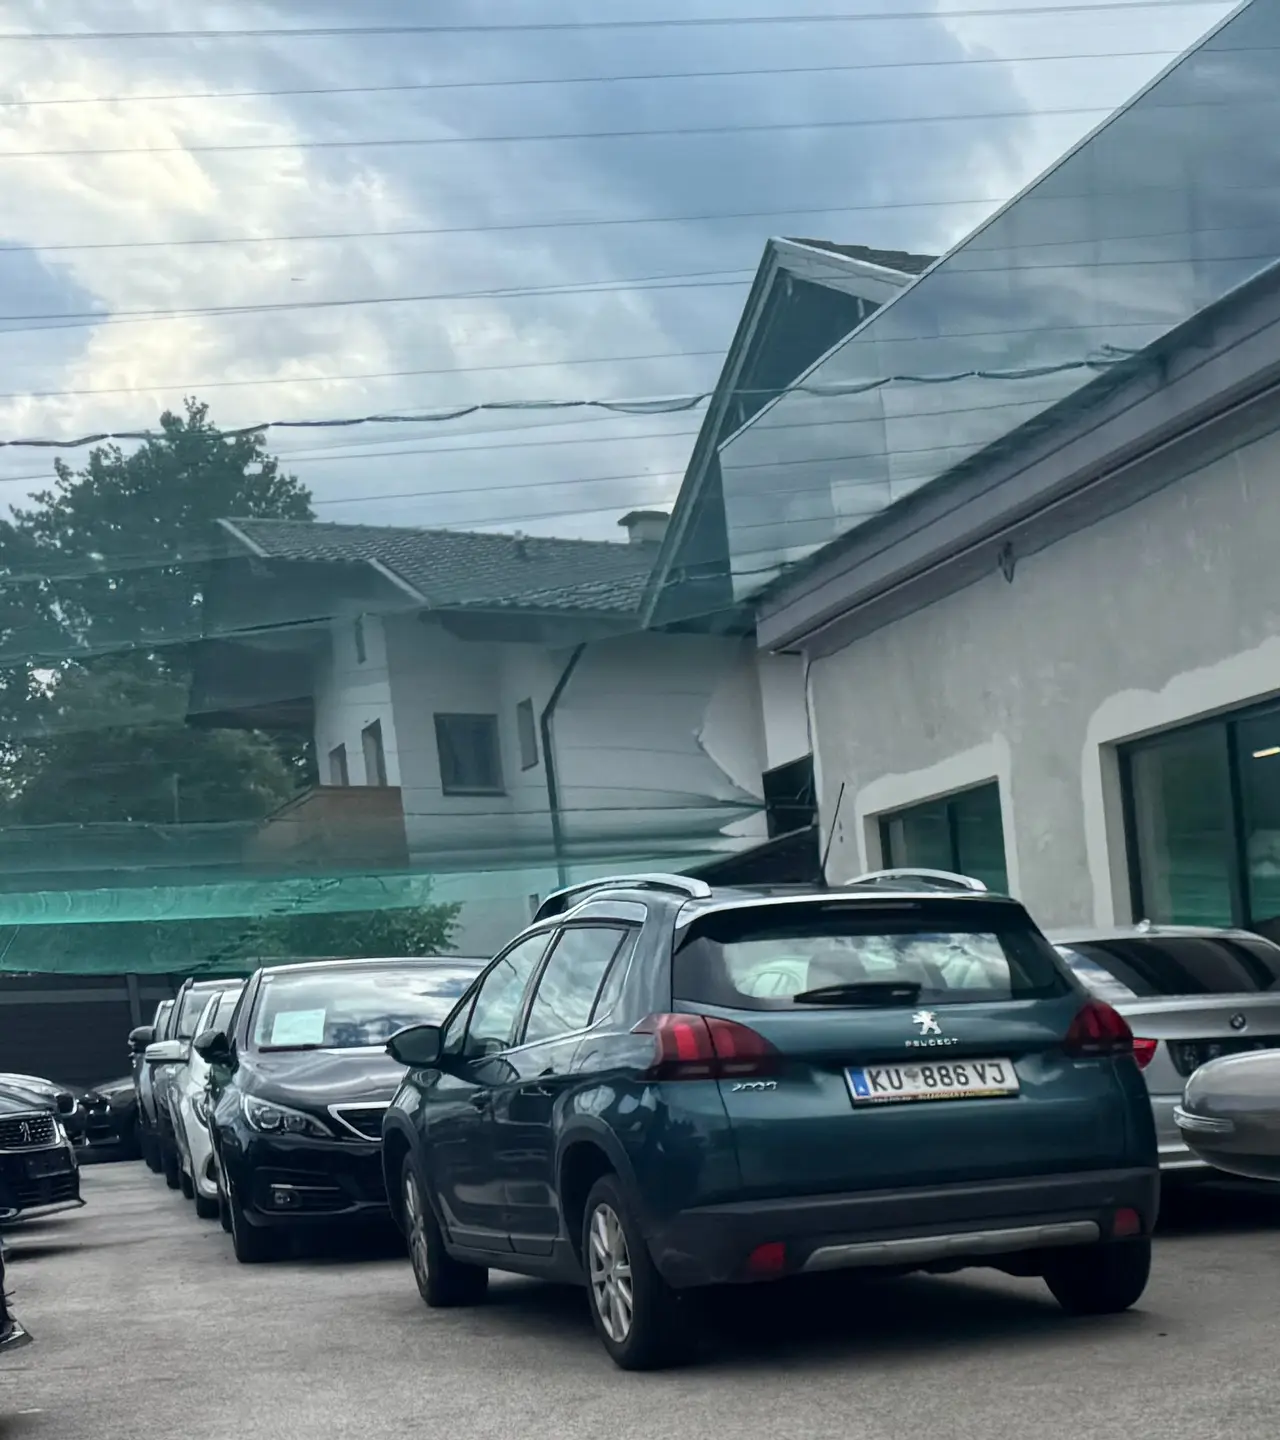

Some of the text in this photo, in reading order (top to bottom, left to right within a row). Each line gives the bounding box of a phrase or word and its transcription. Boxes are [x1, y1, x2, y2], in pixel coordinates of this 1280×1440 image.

[905, 1037, 958, 1048] PEUGEOT
[869, 1062, 1006, 1093] KU 886 VJ
